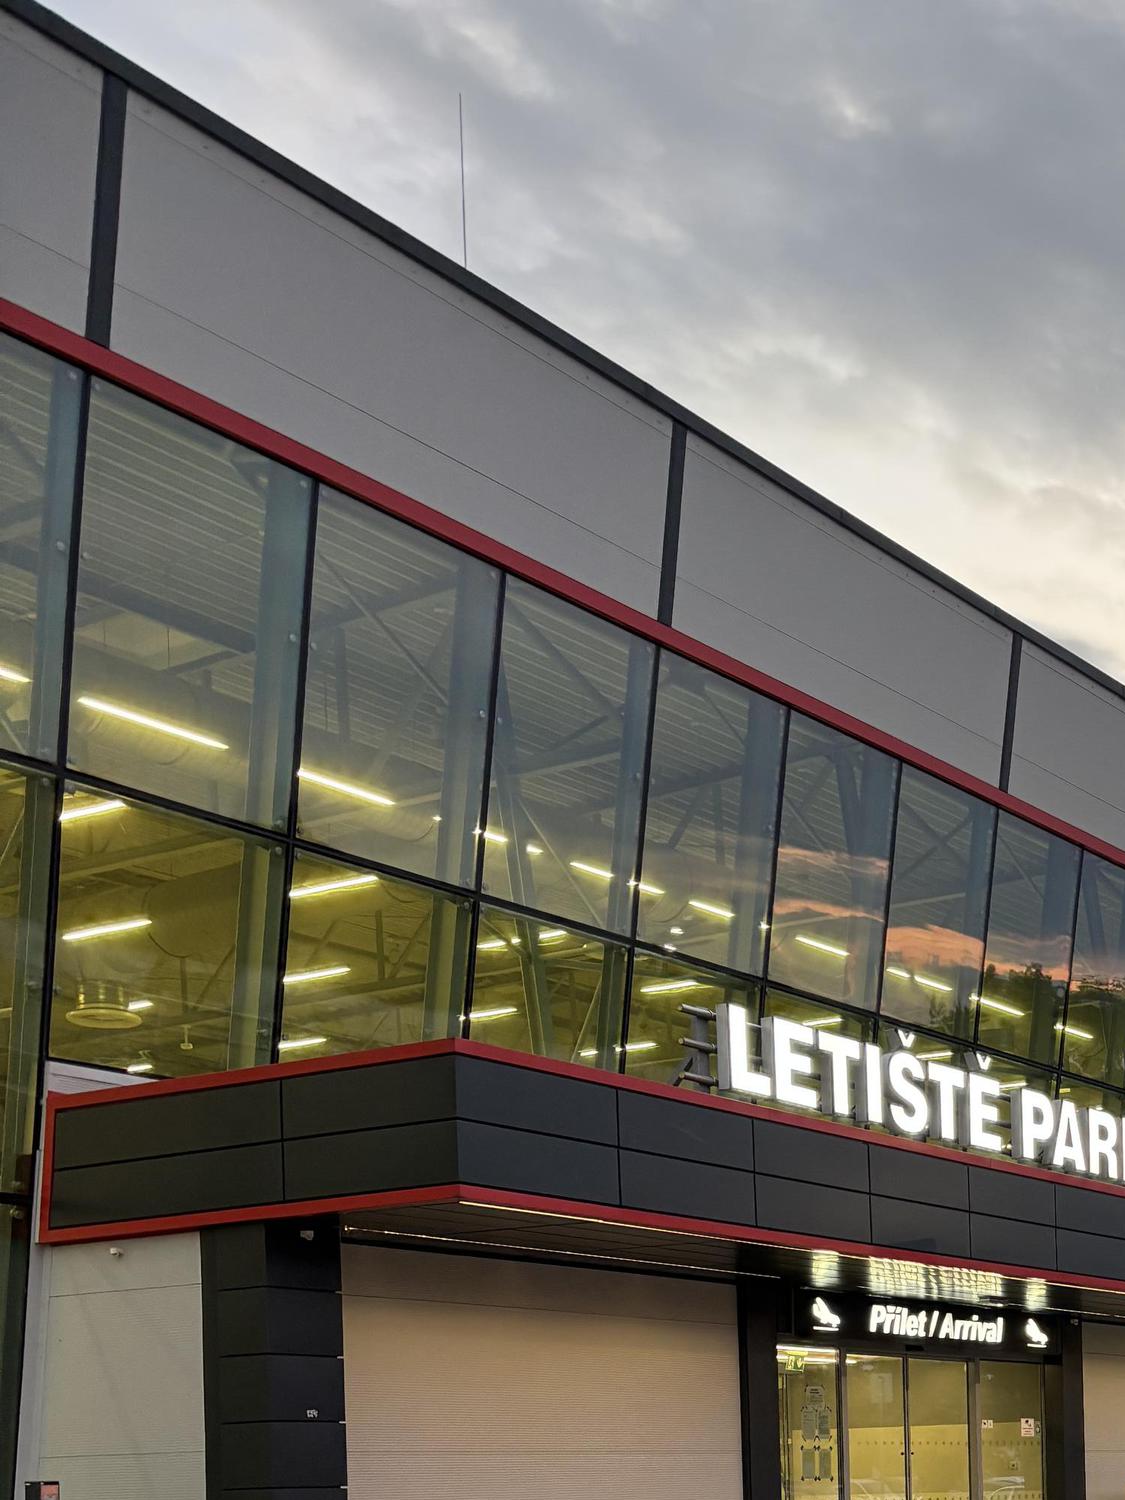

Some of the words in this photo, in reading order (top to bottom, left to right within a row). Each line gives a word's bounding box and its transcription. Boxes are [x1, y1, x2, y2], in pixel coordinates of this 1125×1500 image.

[721, 1002, 1003, 1152] LETIŠTĚ
[869, 1304, 927, 1338] Přílet
[938, 1312, 1004, 1343] Arrival
